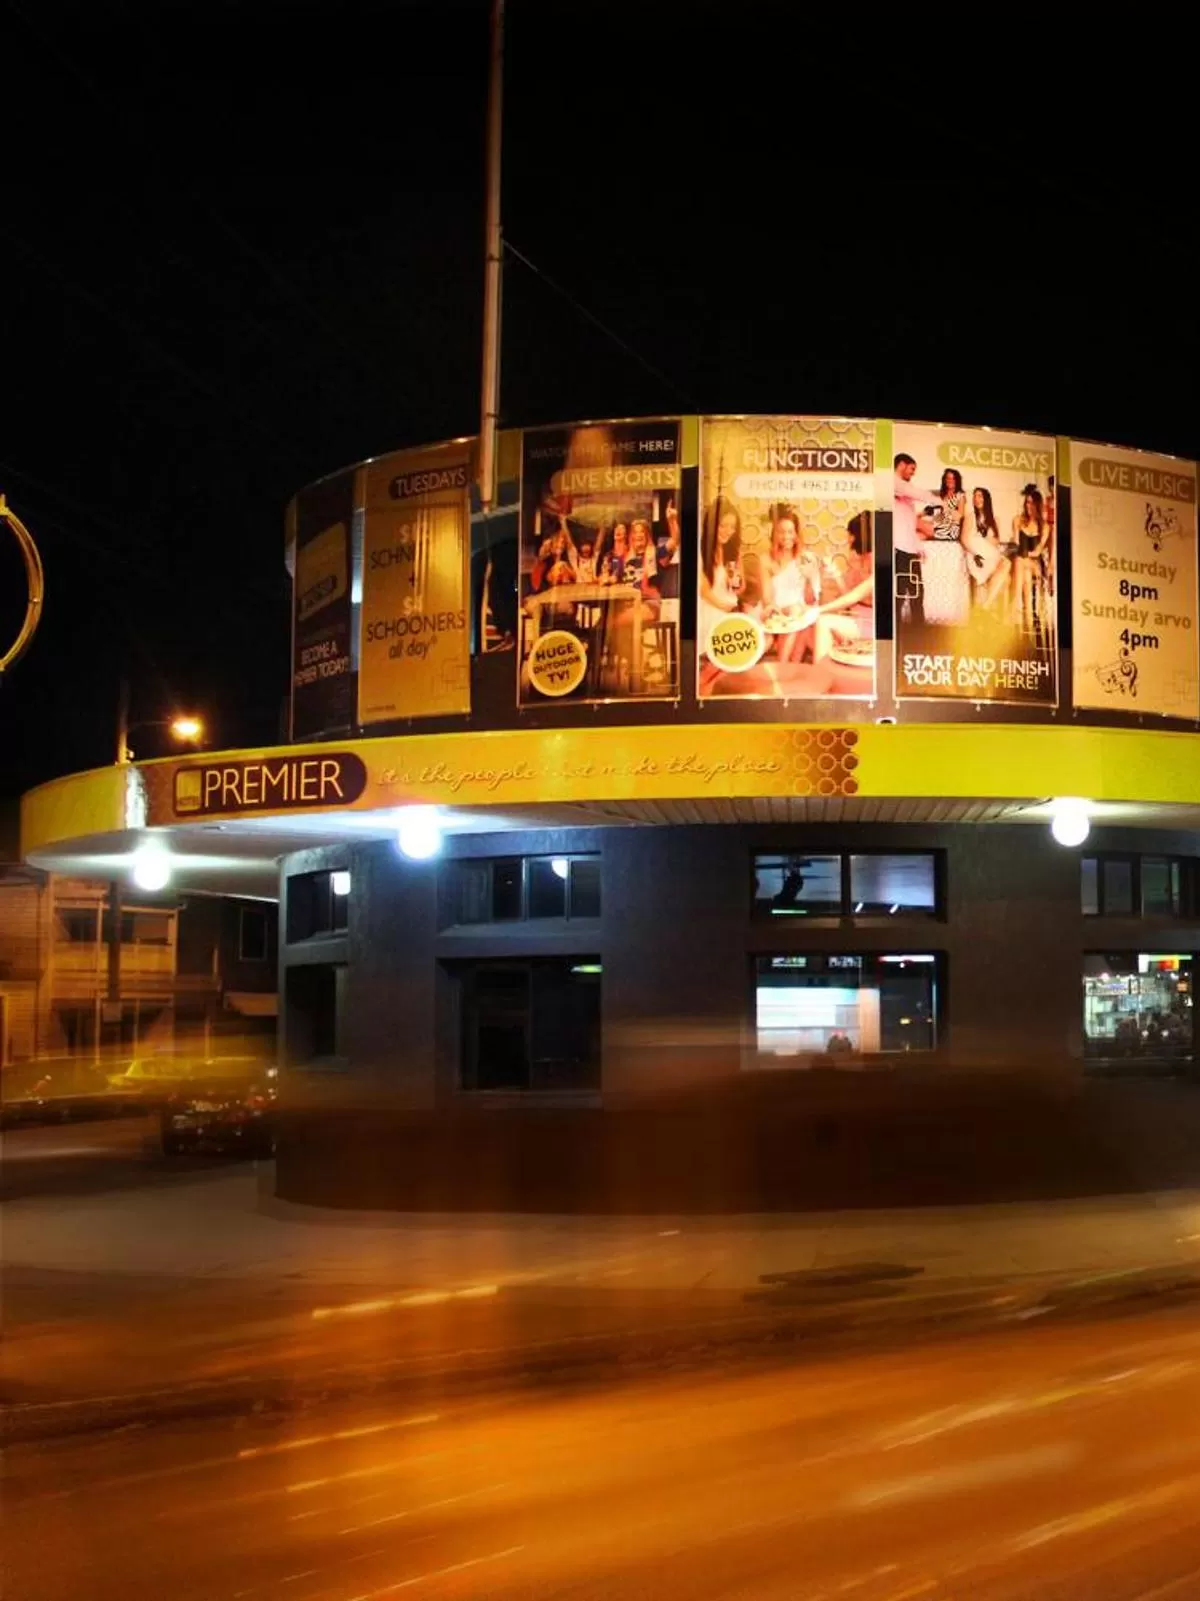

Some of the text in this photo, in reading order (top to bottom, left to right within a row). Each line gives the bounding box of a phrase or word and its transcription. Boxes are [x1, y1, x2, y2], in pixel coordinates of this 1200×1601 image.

[639, 439, 674, 452] HERE!
[743, 450, 868, 469] FUNCTIONS
[949, 445, 1049, 472] RACEDAYS
[396, 467, 466, 498] TUESDAYS
[561, 466, 676, 490] LIVE SPORTS
[749, 479, 795, 492] PHONE
[1089, 462, 1189, 499] LIVE MUSIC
[1096, 551, 1177, 584] Saturday
[1119, 579, 1159, 602] 8pm
[367, 610, 466, 642] SCHOONERS
[1080, 599, 1191, 630] Sunday arvo
[711, 628, 755, 645] BOOK
[1119, 628, 1159, 653] 4pm
[388, 640, 405, 659] all
[535, 642, 574, 661] HUGE
[713, 640, 757, 658] NOW!
[533, 656, 581, 674] OUTDOOR
[903, 653, 1049, 677] START AND FINISH
[547, 669, 570, 685] TV!
[904, 670, 1039, 691] YOUR DAY HERE!
[419, 761, 454, 783] the
[451, 761, 537, 792] people
[667, 750, 706, 775] the
[203, 759, 344, 808] PREMIER
